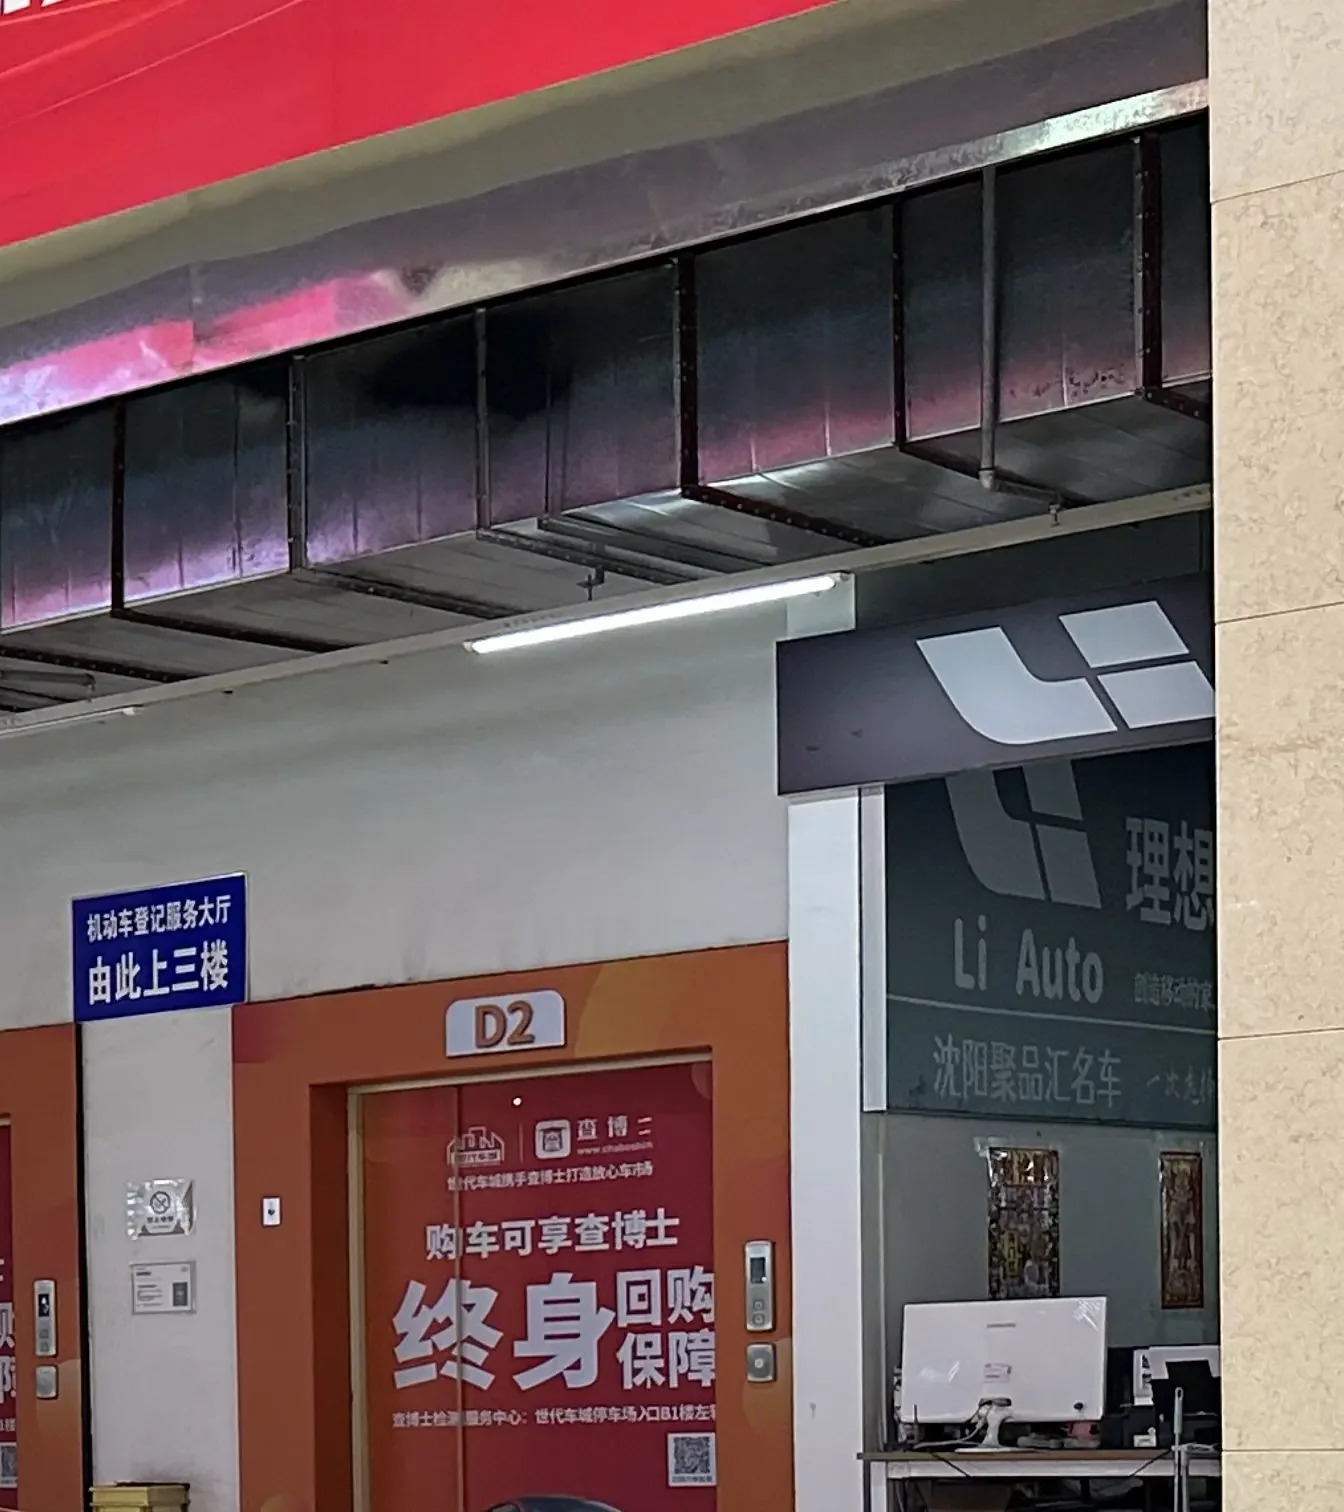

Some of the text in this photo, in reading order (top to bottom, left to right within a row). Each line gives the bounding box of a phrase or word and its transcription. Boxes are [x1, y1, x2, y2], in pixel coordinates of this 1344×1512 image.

[1125, 816, 1214, 931] 理想
[87, 894, 231, 943] 机动车登记服务大厅
[89, 938, 228, 1005] 由此上三楼
[953, 915, 1104, 1004] Li Auto
[474, 1001, 534, 1050] D2
[933, 1033, 1123, 1108] 沈阳聚品汇名车
[426, 1208, 679, 1260] 购车可享查博士
[616, 1265, 715, 1328] 回购
[392, 1272, 616, 1391] 终身
[616, 1328, 716, 1391] 保障
